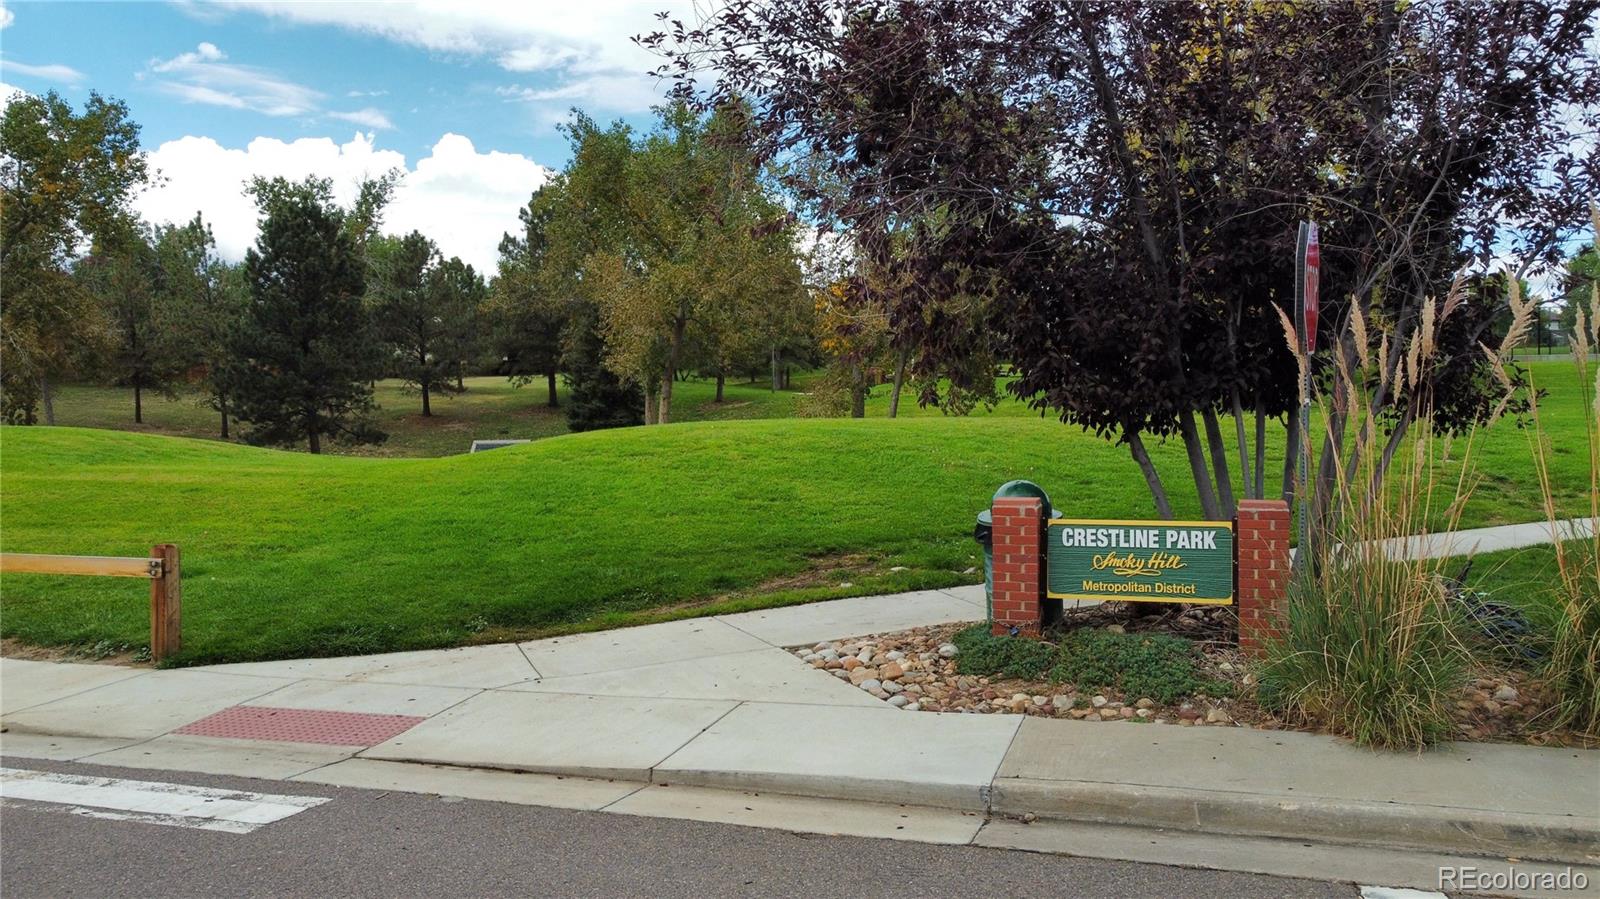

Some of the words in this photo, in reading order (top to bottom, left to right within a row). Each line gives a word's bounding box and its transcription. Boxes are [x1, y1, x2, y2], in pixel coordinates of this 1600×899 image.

[1062, 528, 1159, 548] CRESTLINE
[1166, 530, 1217, 549] PARK
[1091, 551, 1145, 570] Smoky
[1148, 552, 1187, 569] Hill
[1082, 581, 1151, 593] Metropolitan
[1155, 582, 1196, 594] District
